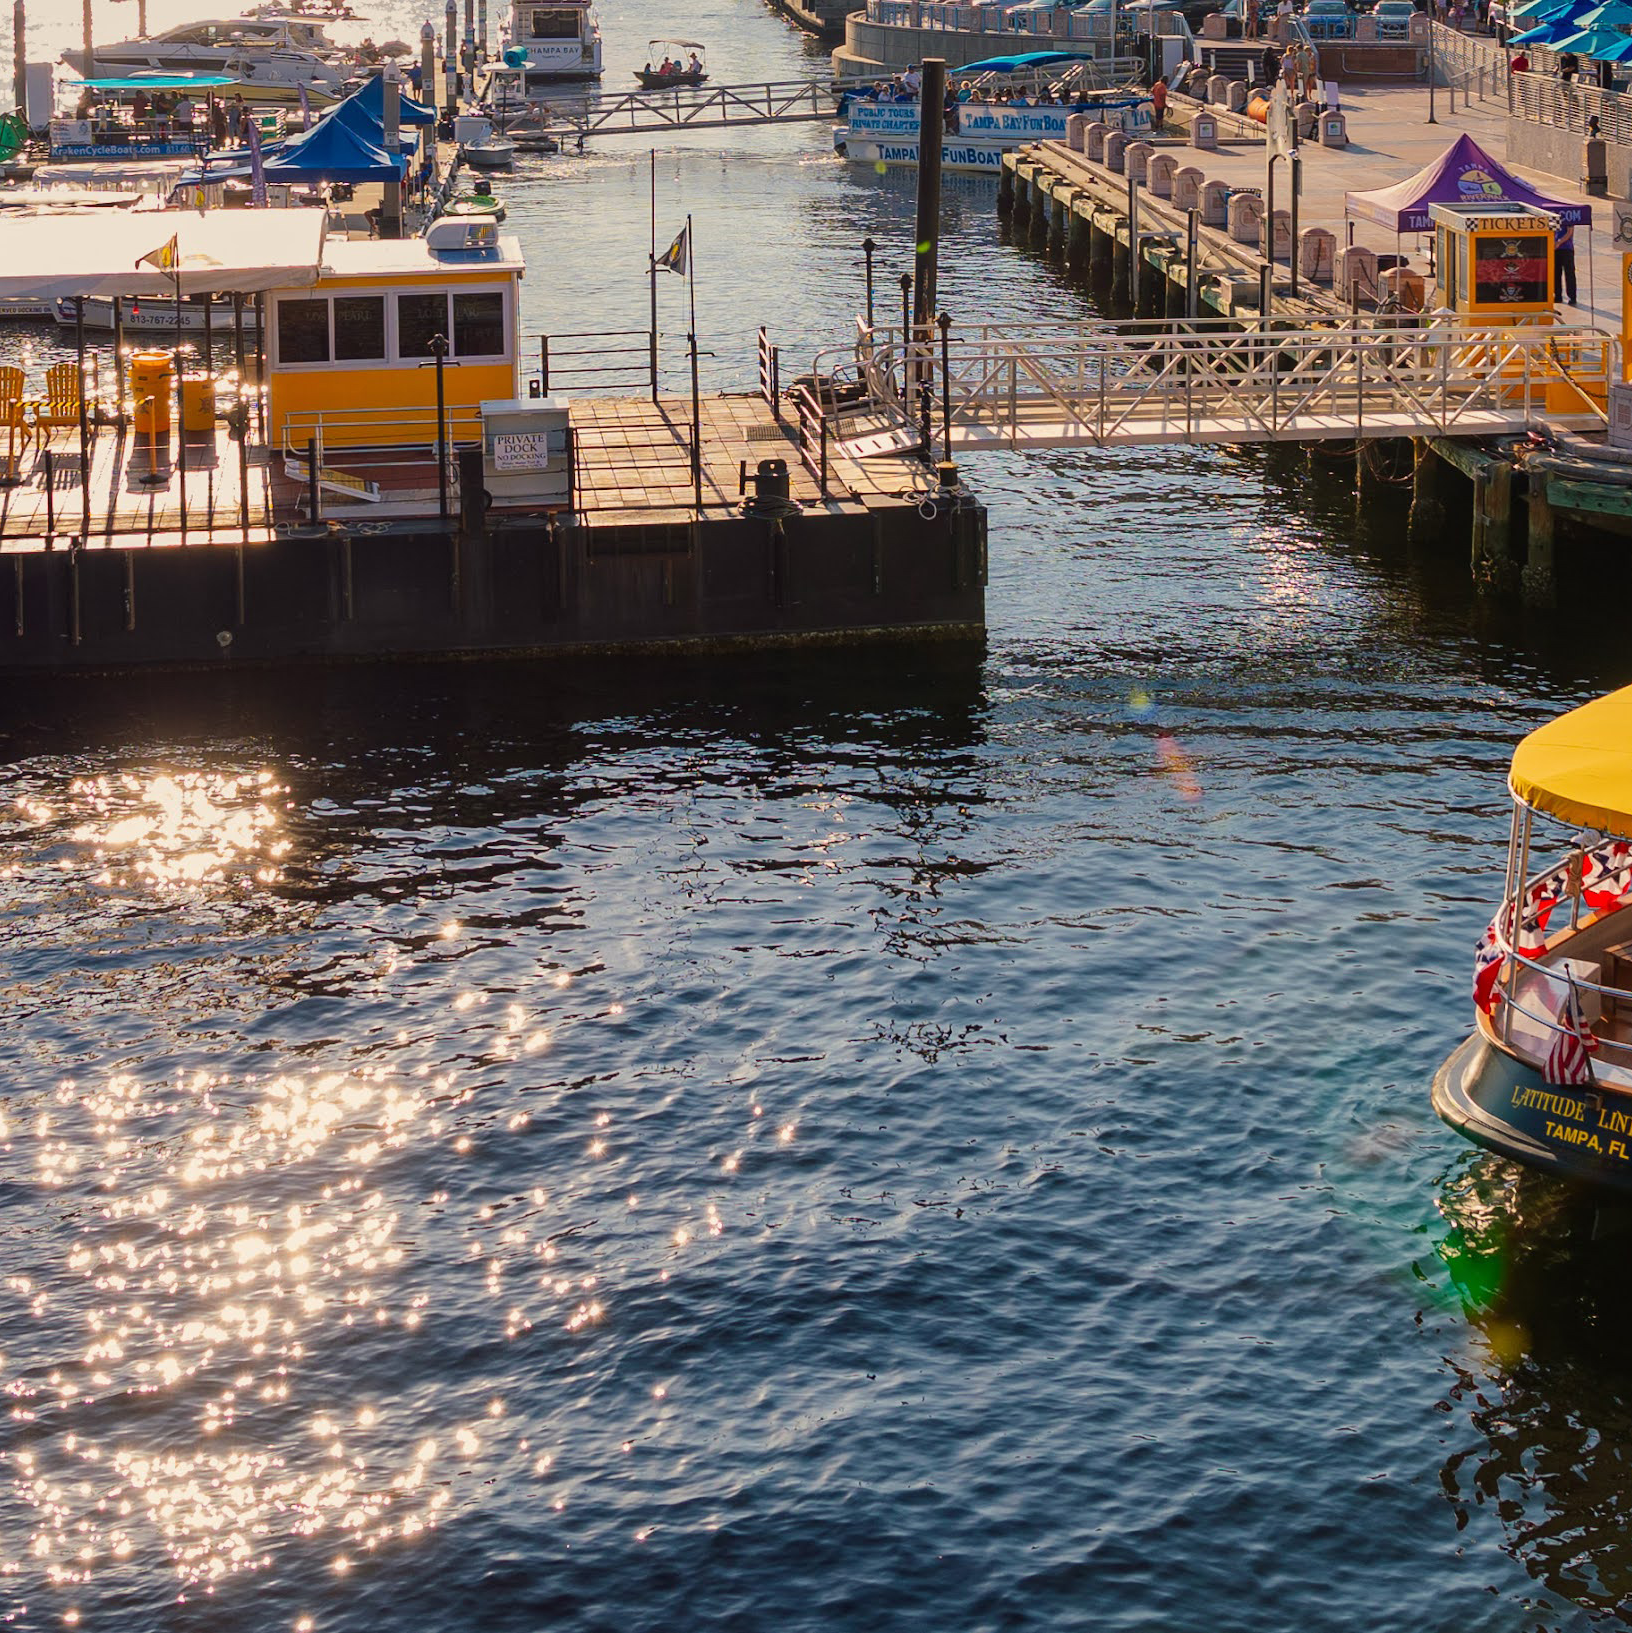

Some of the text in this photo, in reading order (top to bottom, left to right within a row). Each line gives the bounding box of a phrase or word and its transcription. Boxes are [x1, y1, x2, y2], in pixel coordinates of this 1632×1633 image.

[858, 108, 916, 118] PUBLIC TOURS
[966, 113, 1001, 129] TAMPA
[1480, 218, 1546, 232] TICKETS
[498, 434, 545, 445] PRIVATE
[504, 443, 538, 453] DOCK
[1511, 1085, 1587, 1122] LATITUDE
[1546, 1121, 1630, 1160] TAMPA, FL
